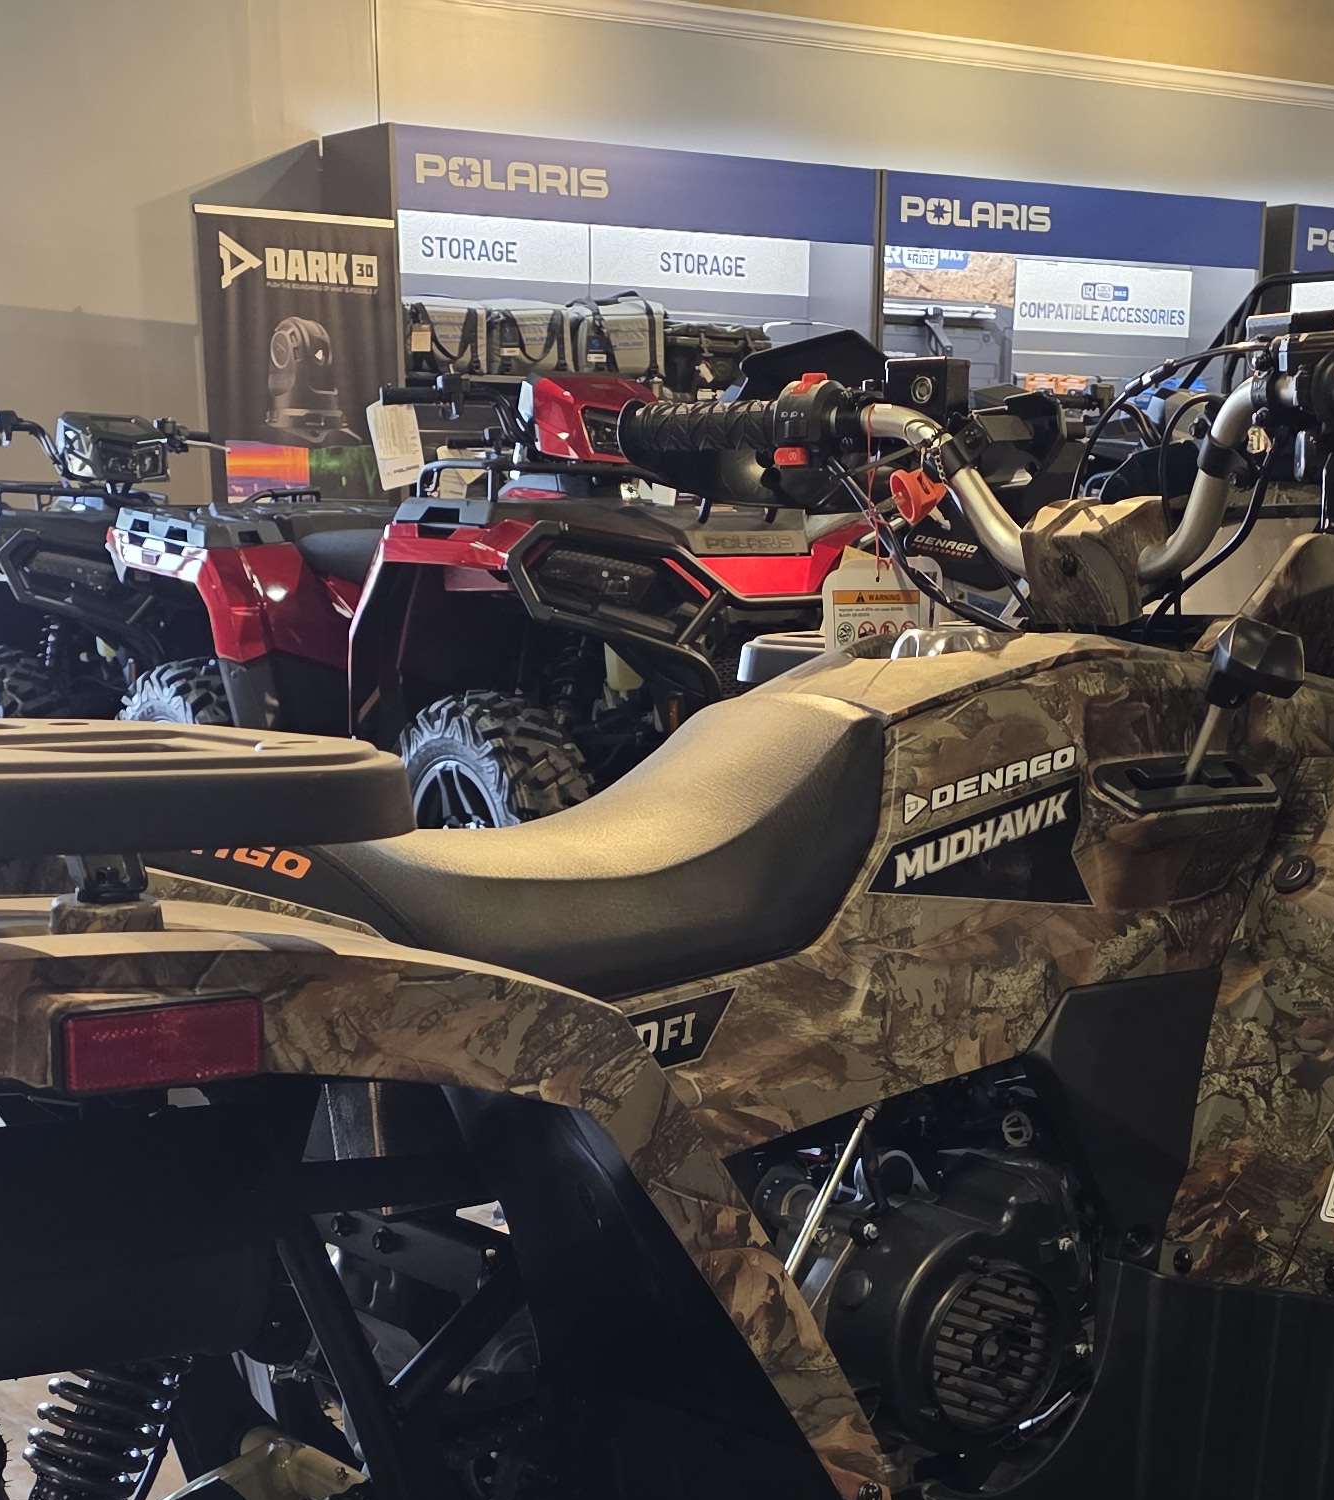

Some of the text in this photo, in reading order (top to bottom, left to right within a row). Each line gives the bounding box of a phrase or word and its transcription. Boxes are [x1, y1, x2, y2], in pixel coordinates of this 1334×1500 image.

[415, 152, 609, 199] POLARIS
[900, 195, 1052, 233] POLARIS
[421, 235, 519, 264] STORAGE
[265, 247, 348, 285] DARK
[659, 251, 747, 278] STORAGE
[1019, 302, 1186, 326] COMPATIBLE ACCESSORIES
[704, 535, 795, 549] POLARIS
[910, 542, 973, 559] POWERSPORTS
[913, 534, 979, 554] DENAGO
[868, 593, 901, 602] WARNING
[931, 746, 1076, 811] DENAGO
[893, 788, 1074, 889] MUDHAWK
